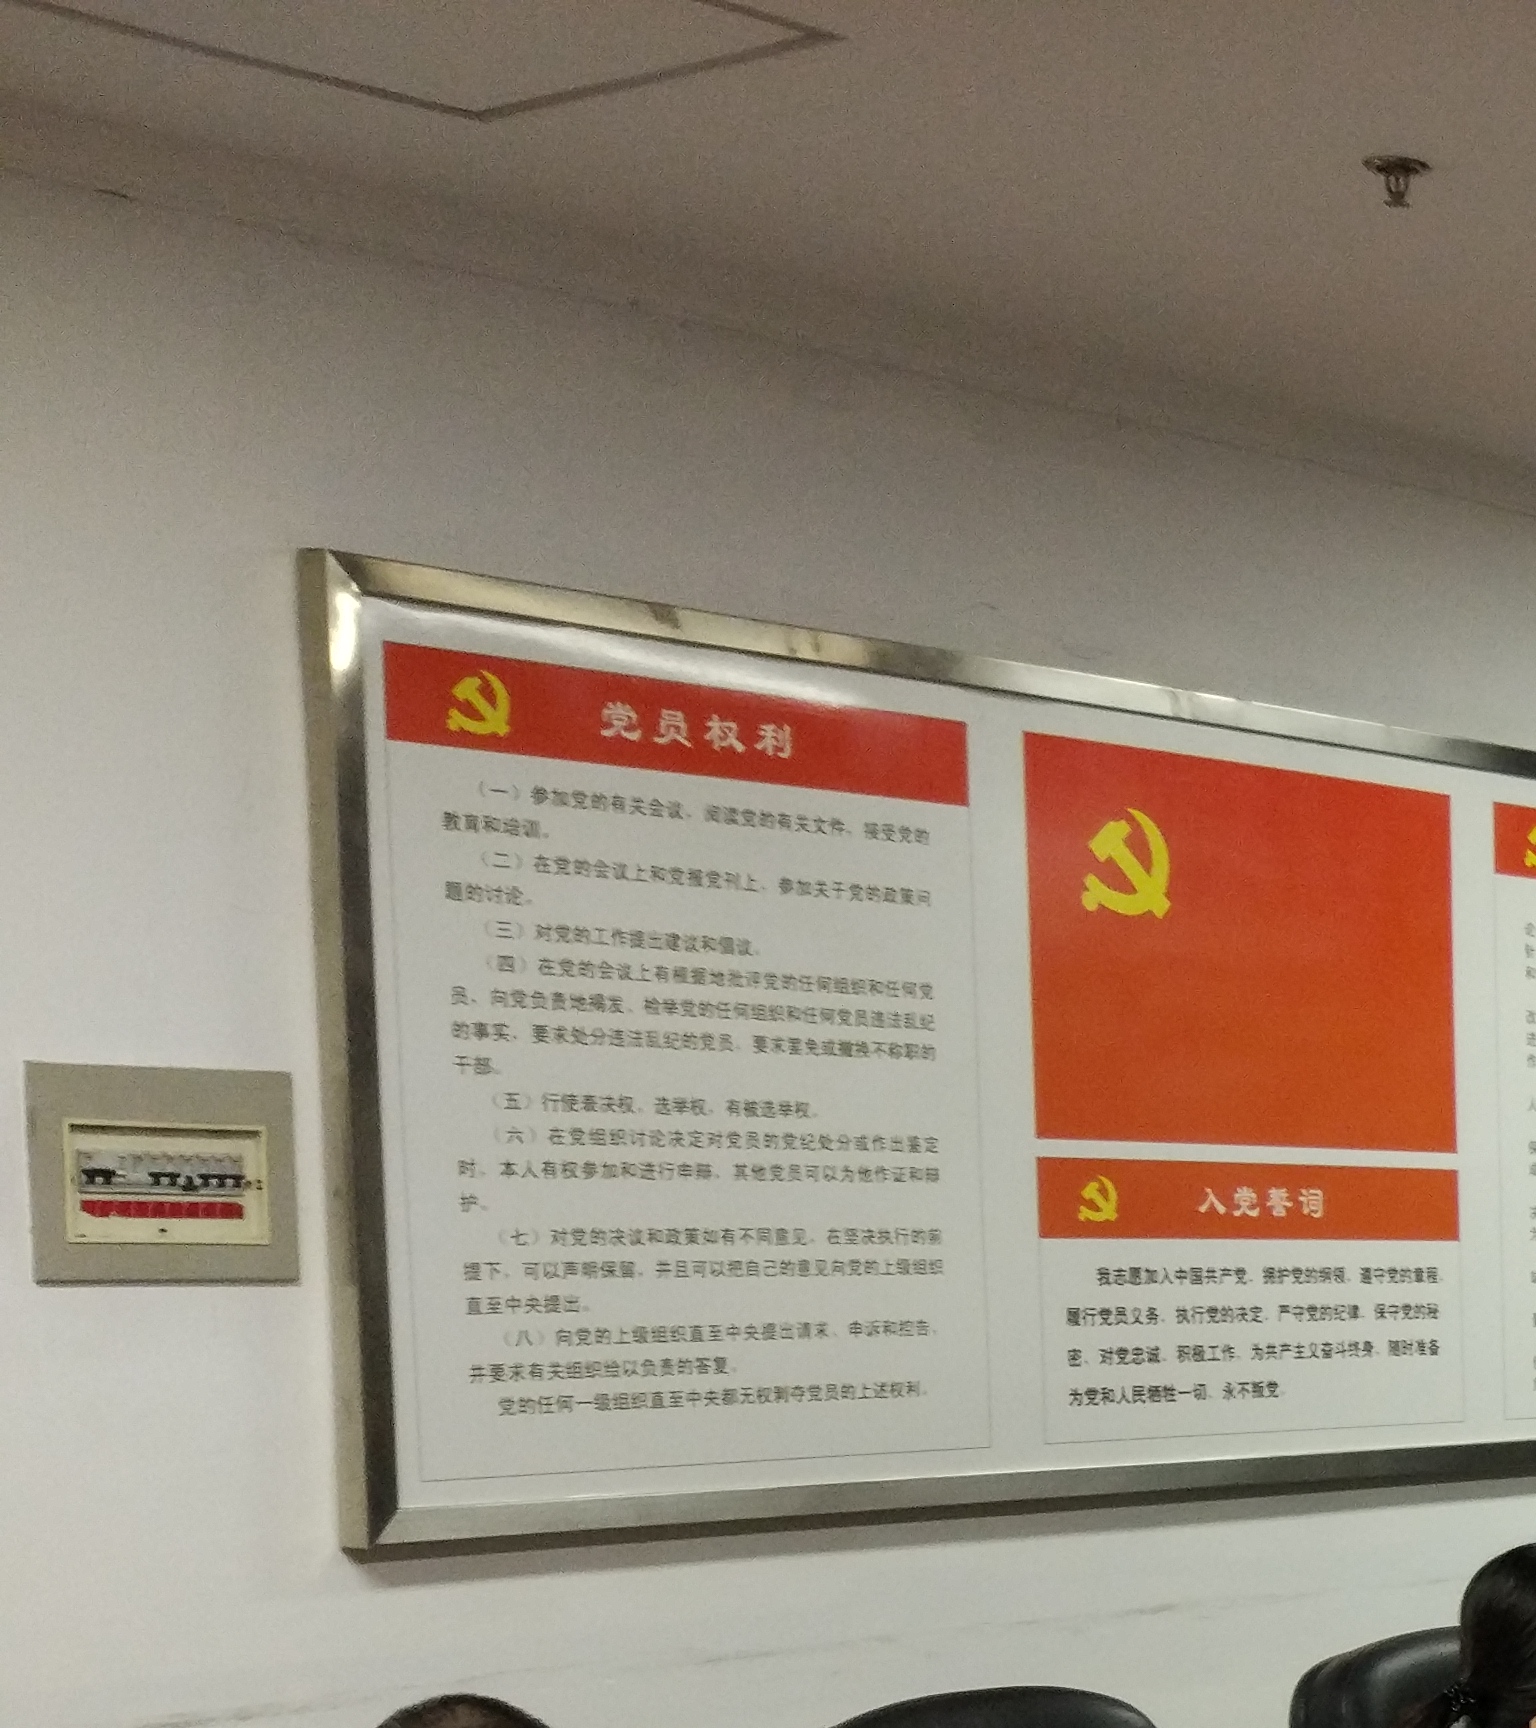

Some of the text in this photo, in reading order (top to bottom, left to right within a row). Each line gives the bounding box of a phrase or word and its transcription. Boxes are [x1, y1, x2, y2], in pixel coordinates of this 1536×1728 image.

[599, 701, 795, 759] 党员权利
[1198, 1187, 1327, 1218] 入党誓词
